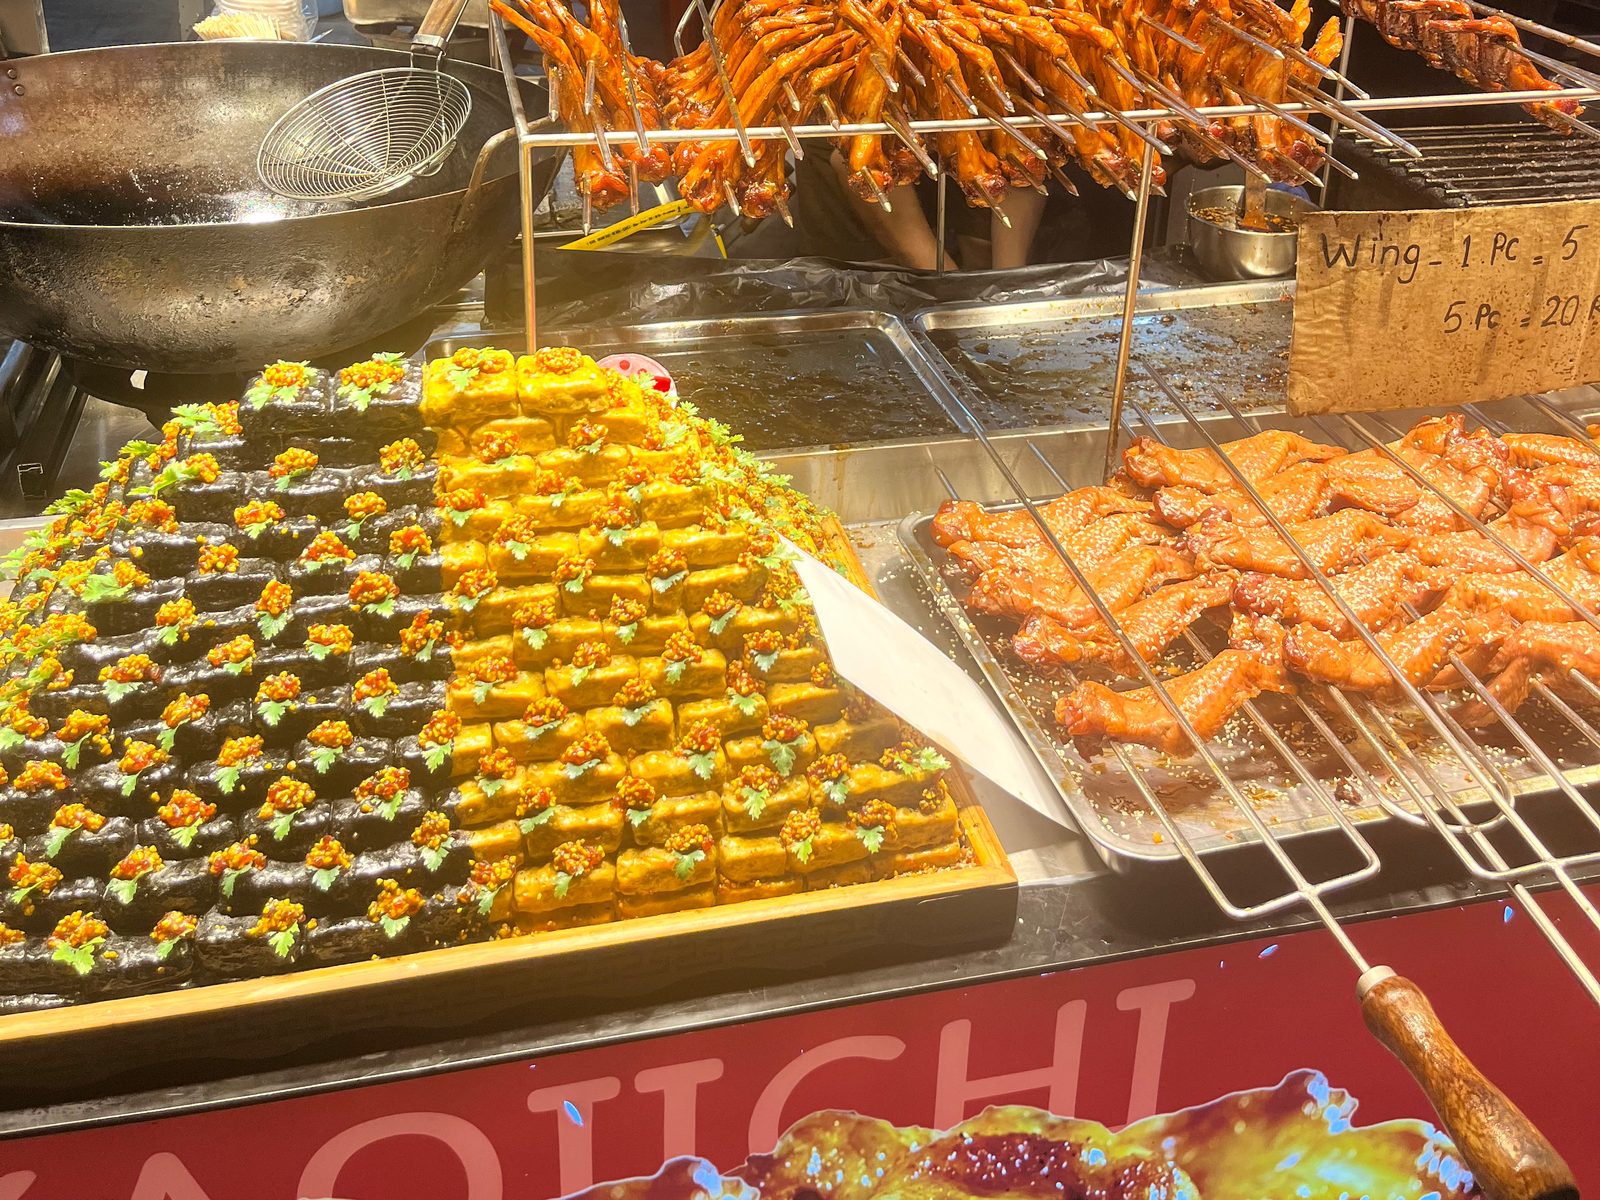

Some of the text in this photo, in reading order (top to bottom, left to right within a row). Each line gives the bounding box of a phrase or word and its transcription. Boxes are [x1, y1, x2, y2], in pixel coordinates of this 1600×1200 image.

[1320, 232, 1421, 284] Wing
[1561, 224, 1589, 261] 5
[1540, 294, 1580, 327] 20
